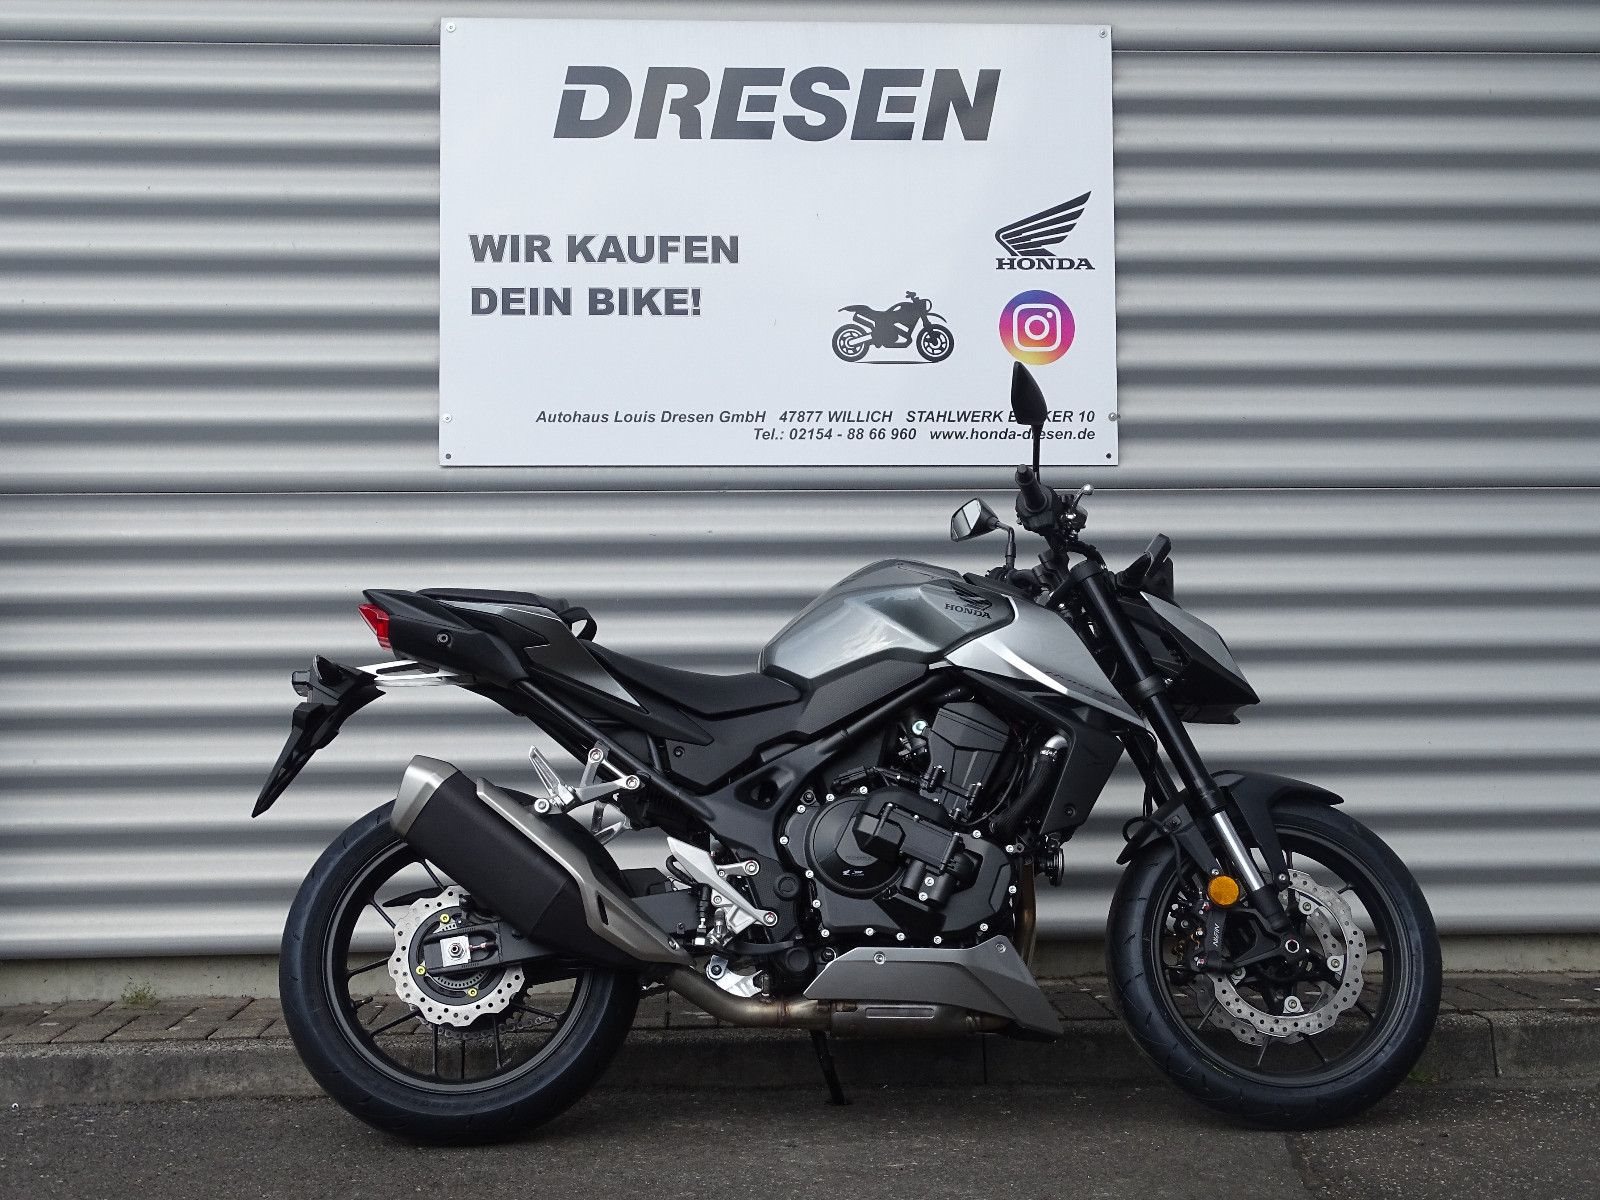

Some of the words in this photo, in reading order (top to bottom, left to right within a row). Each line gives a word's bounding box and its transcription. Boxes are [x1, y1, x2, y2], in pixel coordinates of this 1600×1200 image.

[553, 65, 1002, 142] DRESEN
[469, 234, 553, 264] WIR
[566, 234, 740, 264] KAUFEN
[995, 257, 1096, 271] HONDA
[470, 287, 573, 316] DEIN
[588, 287, 702, 316] BIKE!
[535, 410, 610, 423] Autohaus
[613, 410, 656, 423] Louis
[660, 410, 714, 423] Dresen
[719, 410, 767, 423] GmbH
[778, 410, 824, 423] 47877
[828, 410, 893, 423] WILLICH
[905, 410, 1004, 423] STAHLWERK
[1078, 410, 1096, 423] 10
[753, 427, 785, 441] Tel.:
[789, 427, 833, 440] 02154
[846, 427, 865, 440] 88
[868, 427, 887, 440] 66
[890, 427, 917, 440] 960
[930, 427, 1096, 440] www.honda-desen.de
[944, 603, 992, 620] HONDA
